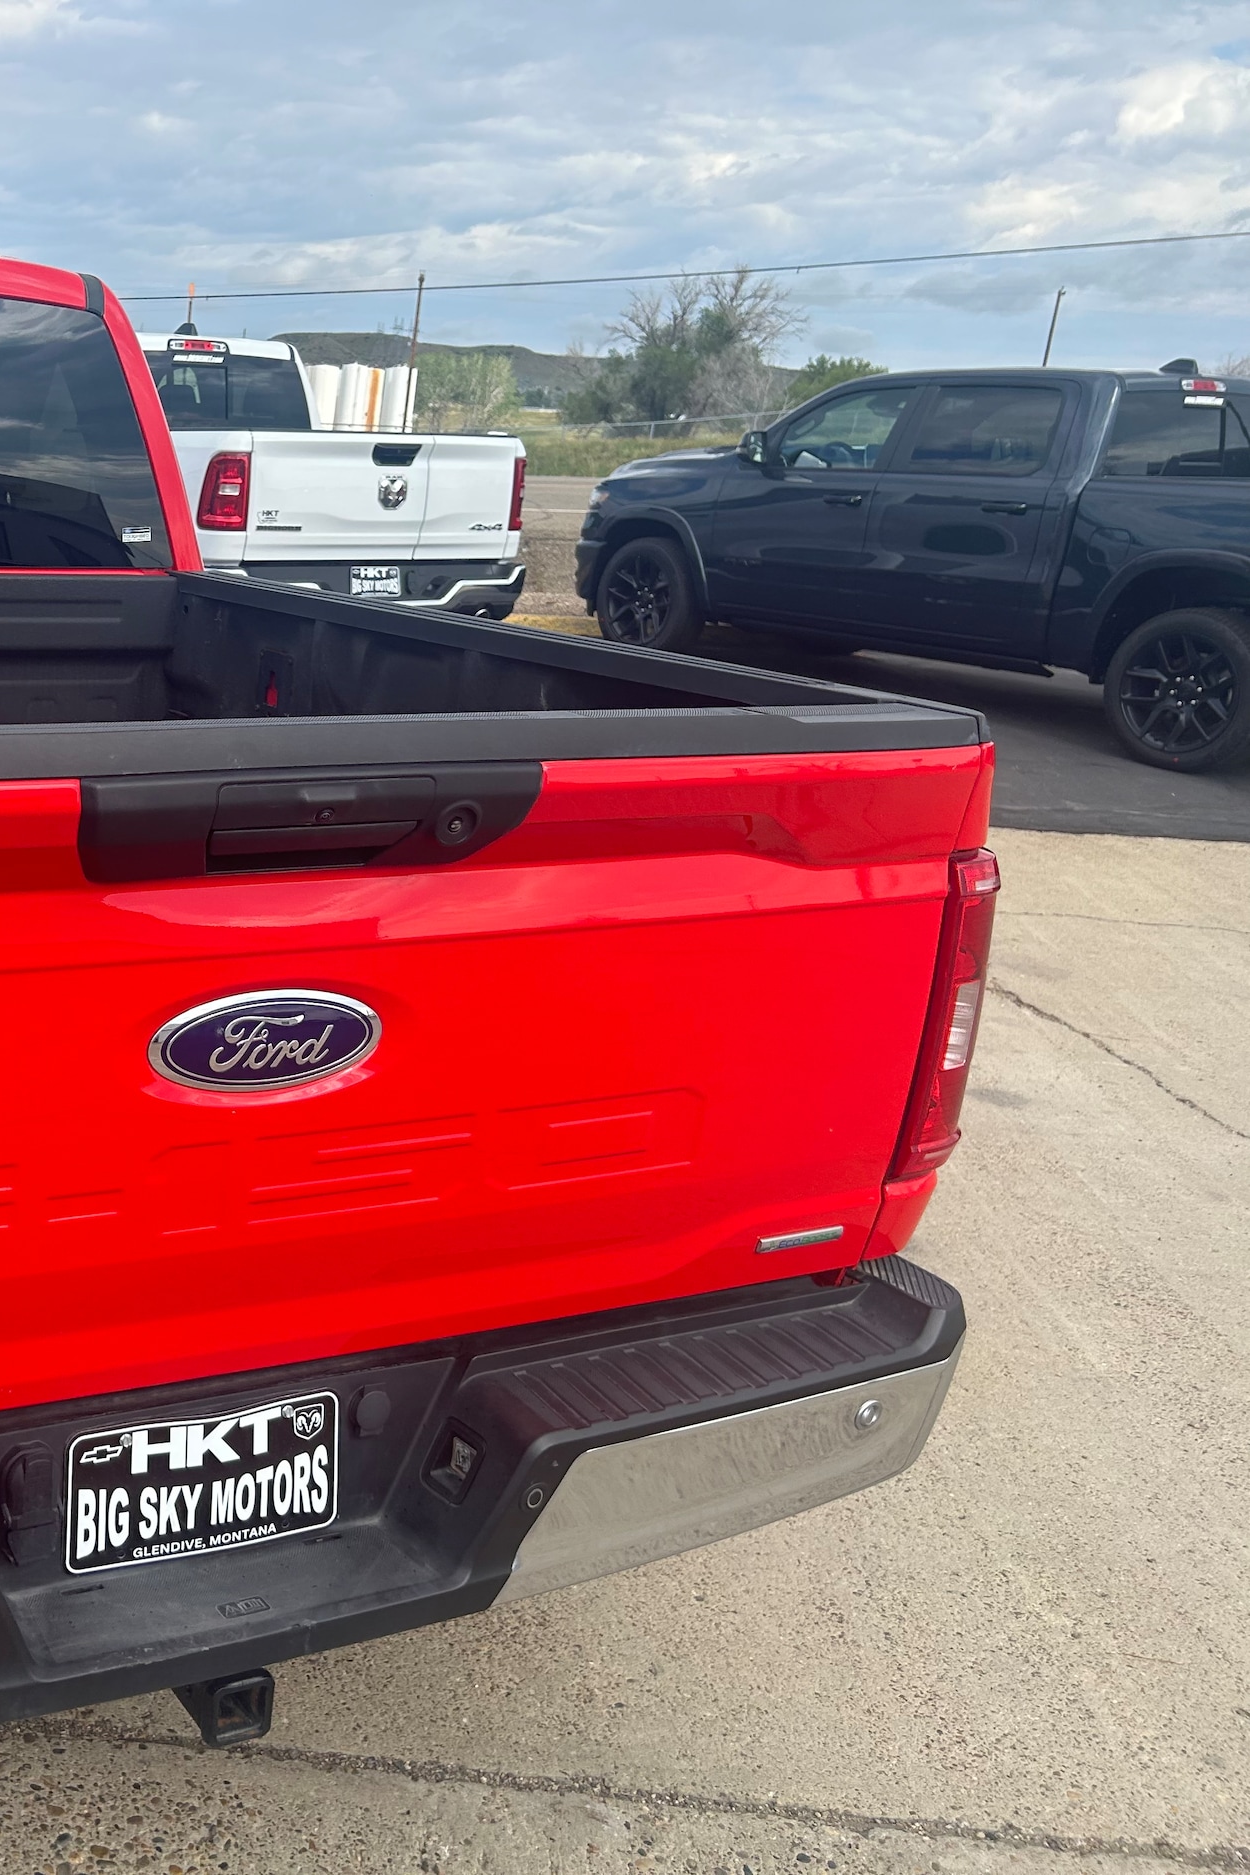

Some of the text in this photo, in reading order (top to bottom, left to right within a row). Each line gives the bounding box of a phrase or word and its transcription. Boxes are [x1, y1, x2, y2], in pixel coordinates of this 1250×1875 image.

[360, 567, 389, 578] HKT
[208, 1013, 335, 1074] Ford
[130, 1406, 282, 1475] HKT
[76, 1444, 330, 1560] BIG SKY MOTORS
[132, 1522, 277, 1560] GLENDIVE, MONTANA
